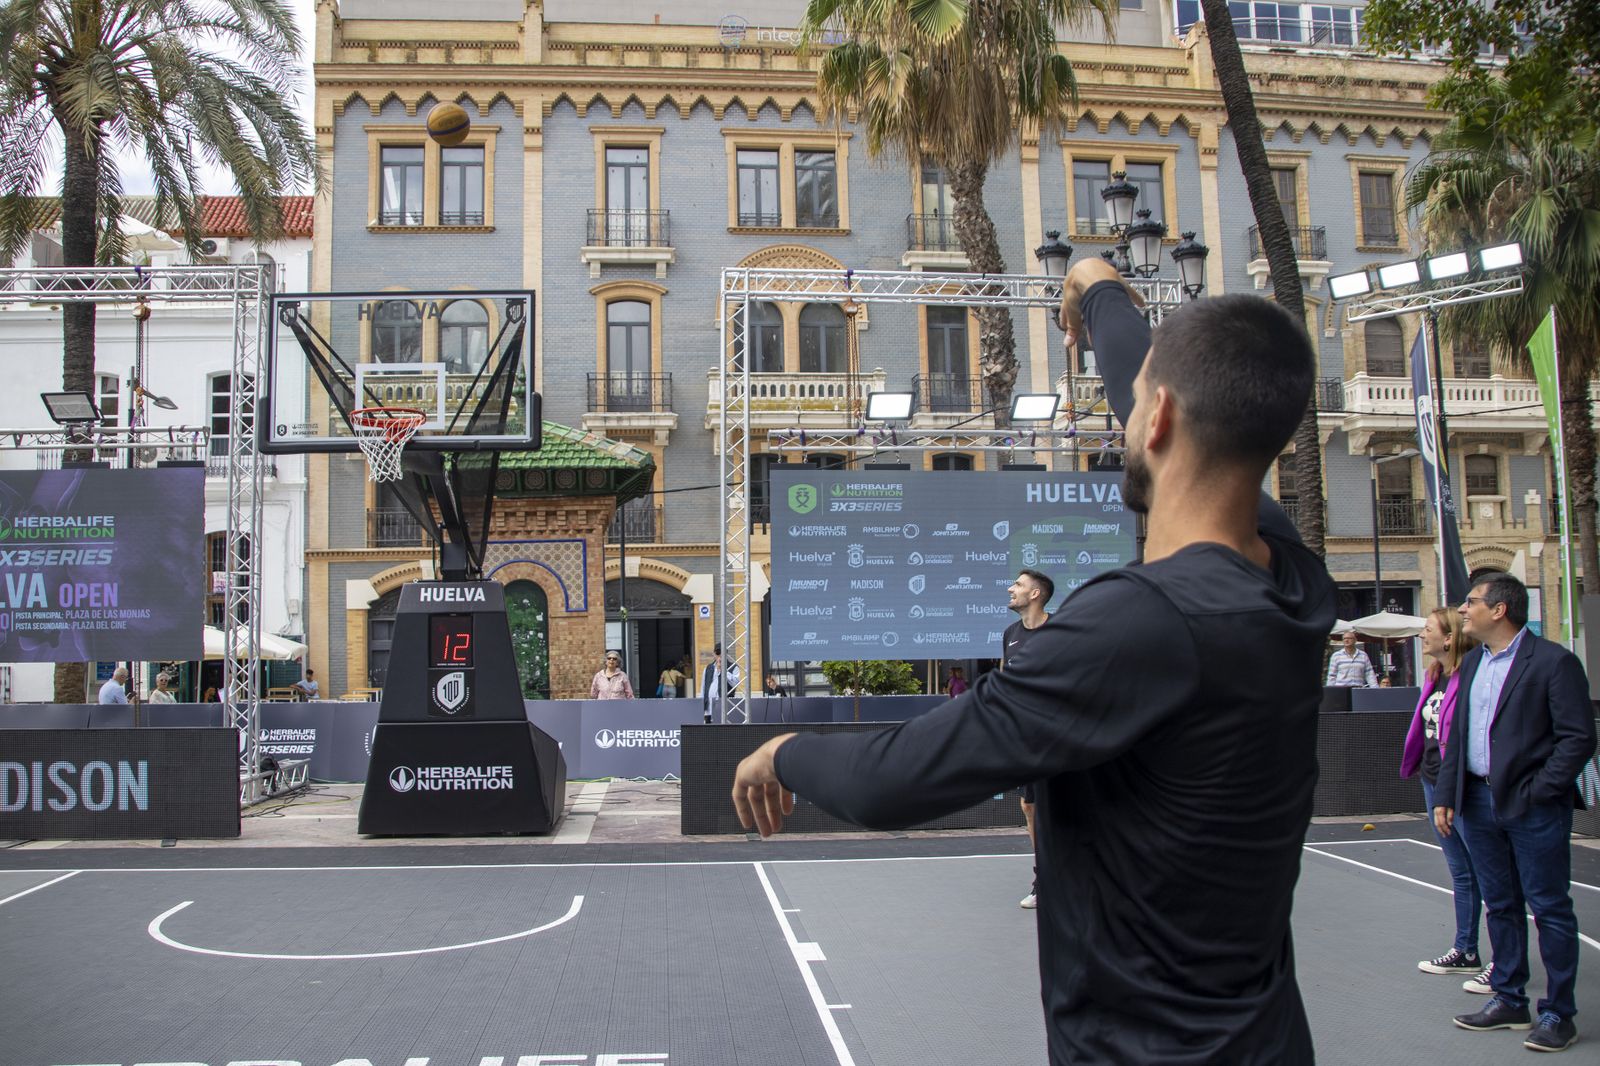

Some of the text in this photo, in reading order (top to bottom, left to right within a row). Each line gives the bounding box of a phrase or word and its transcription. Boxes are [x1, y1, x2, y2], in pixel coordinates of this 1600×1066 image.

[358, 302, 441, 321] HUELVA
[1026, 483, 1123, 503] HUELVA
[830, 502, 903, 512] 3X3SERIES
[1102, 504, 1124, 512] OPEN
[14, 515, 115, 527] HERBALIFE
[14, 527, 115, 538] NUTRITION
[1032, 524, 1064, 533] MADISON
[789, 551, 833, 562] Huelva
[965, 551, 1007, 561] Huelva
[850, 579, 884, 589] MADISON
[0, 572, 119, 609] VA OPEN
[420, 587, 486, 602] HUELVA
[15, 608, 151, 620] PISTA PRINCIPAL: PLAZA DE LAS MONJAS
[790, 605, 833, 616] Huelva
[966, 604, 1008, 614] Huelva
[15, 622, 31, 630] PISTA
[73, 621, 95, 630] PLAZA
[96, 620, 110, 630] DEL
[111, 620, 127, 629] CINE
[443, 633, 470, 661] 12
[616, 730, 682, 739] HERBALIF
[616, 739, 681, 748] NUTRITIO
[417, 766, 513, 778] HERBALIFE
[0, 760, 149, 812] DISON
[417, 778, 513, 791] NUTRITION
